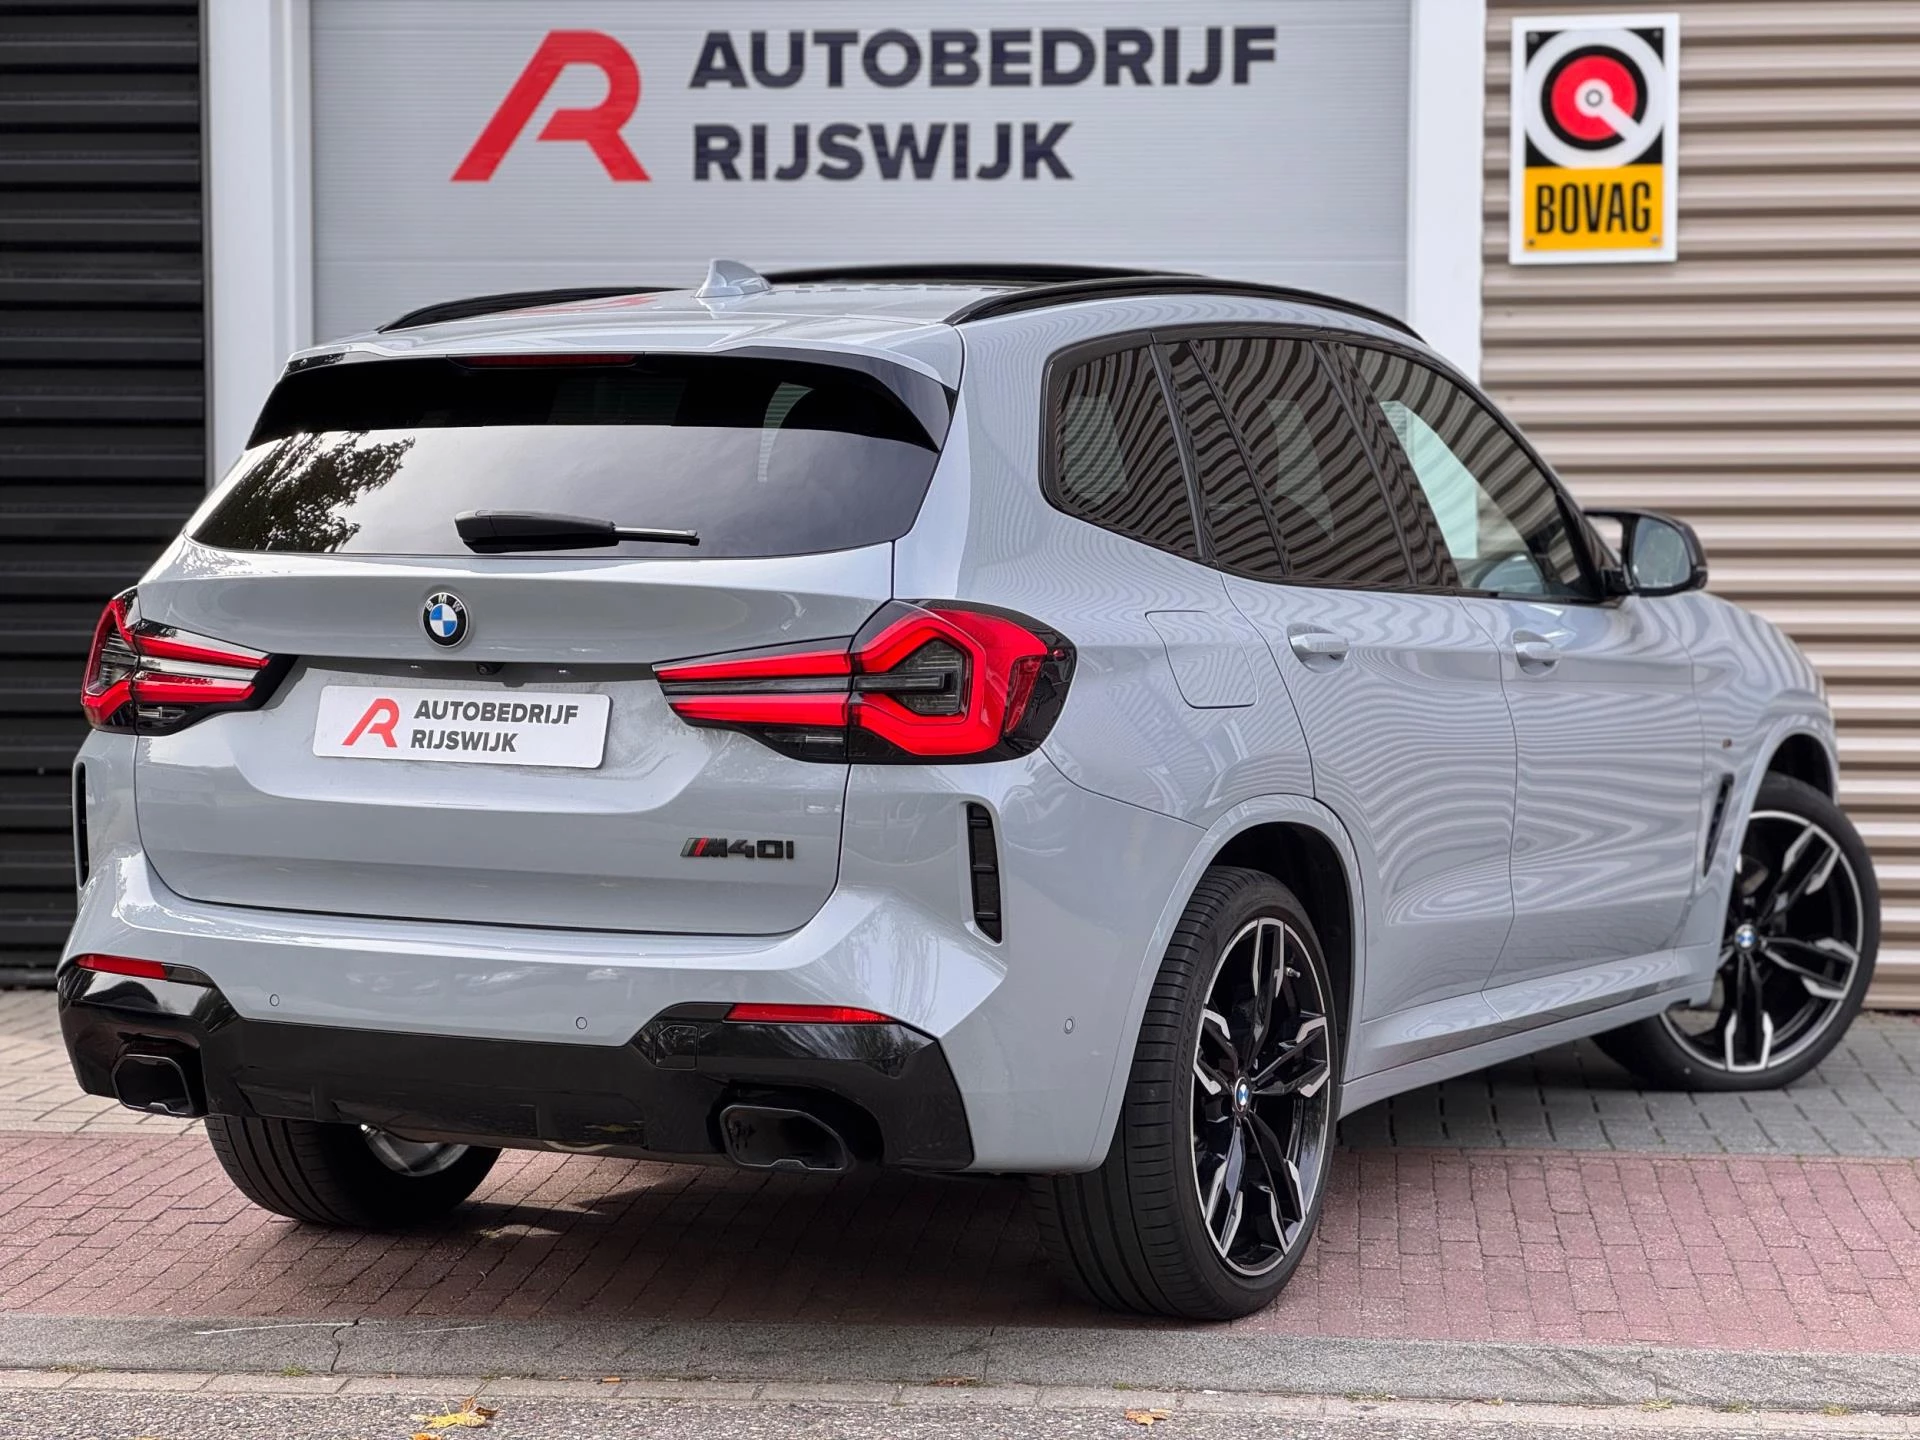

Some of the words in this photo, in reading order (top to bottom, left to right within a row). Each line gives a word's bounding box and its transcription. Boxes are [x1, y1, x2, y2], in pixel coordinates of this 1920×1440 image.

[690, 26, 1276, 88] AUTOBEDRIJF
[694, 122, 1073, 181] RIJSWIJK
[1536, 181, 1651, 235] BOVAG
[414, 699, 579, 725] AUTOBEDRIJF
[410, 729, 518, 753] RIJSWIJK
